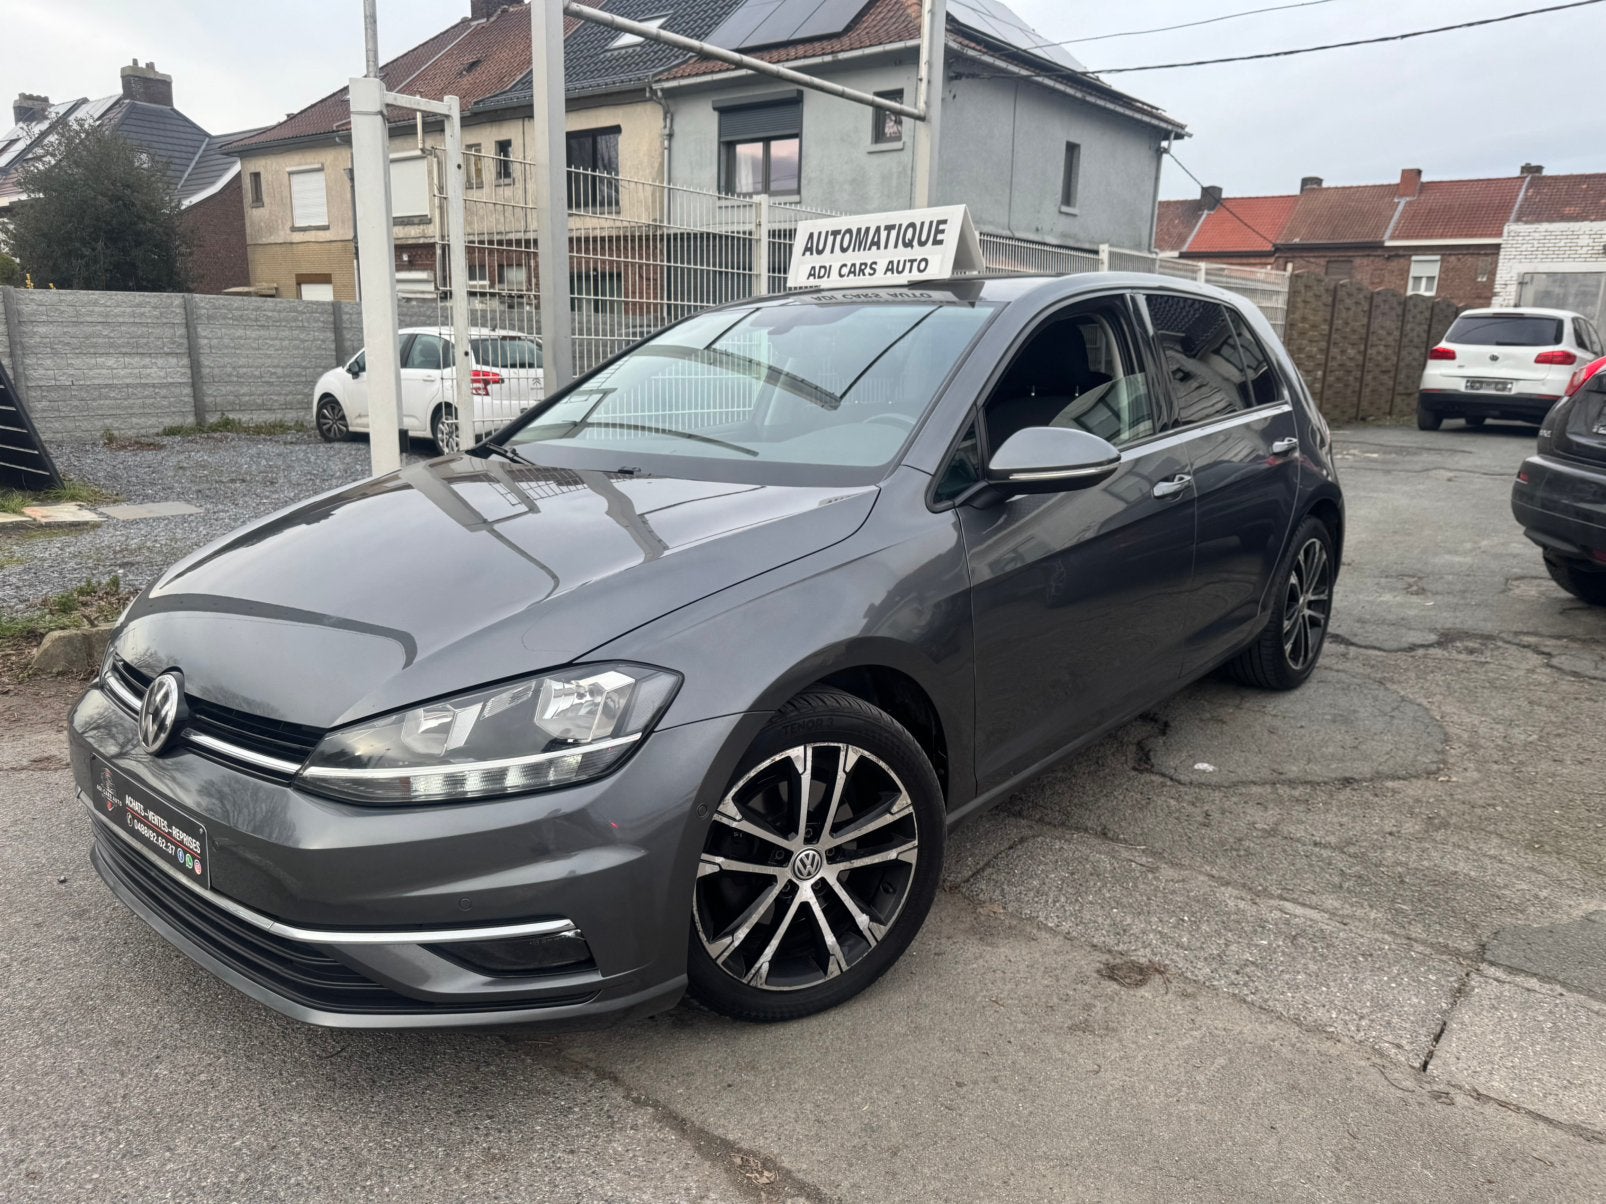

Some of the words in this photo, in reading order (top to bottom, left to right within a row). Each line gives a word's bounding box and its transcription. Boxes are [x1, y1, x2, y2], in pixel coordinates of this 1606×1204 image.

[802, 218, 948, 257] AUTOMATIQUE
[806, 265, 832, 281] ADI
[838, 261, 878, 278] CARS
[883, 257, 929, 276] AUTO
